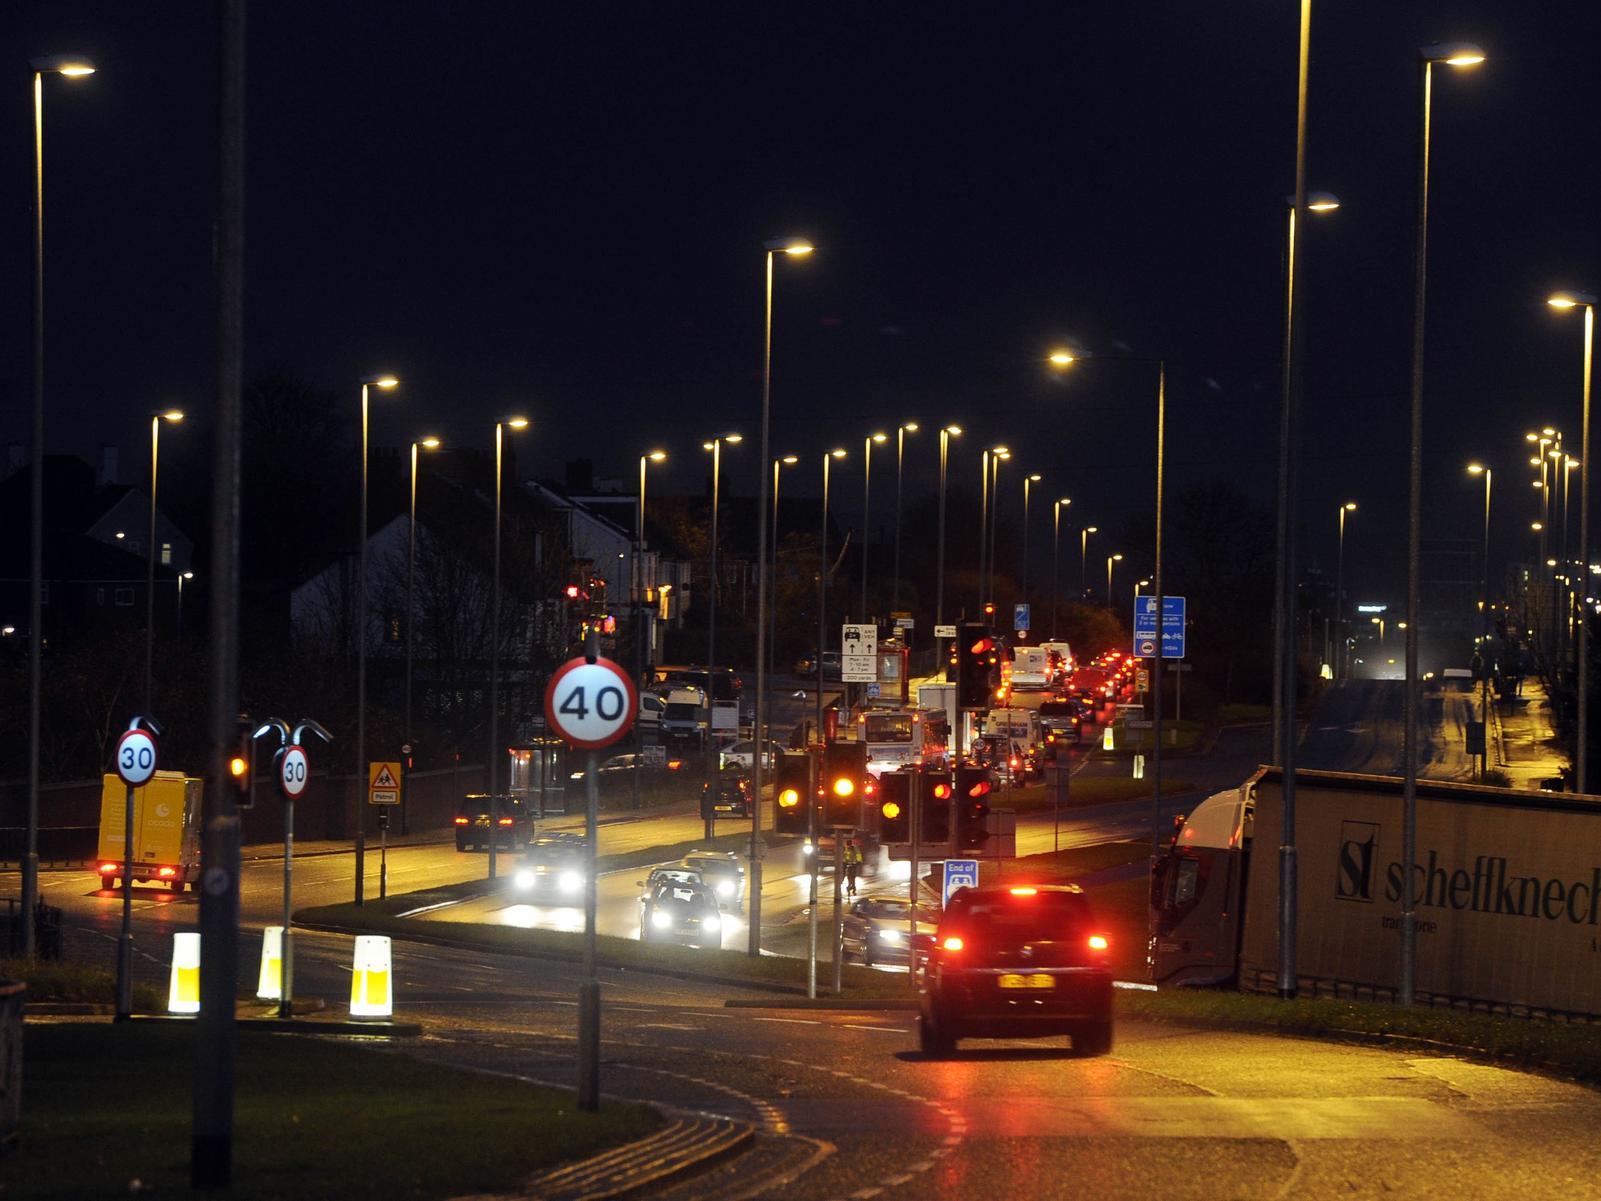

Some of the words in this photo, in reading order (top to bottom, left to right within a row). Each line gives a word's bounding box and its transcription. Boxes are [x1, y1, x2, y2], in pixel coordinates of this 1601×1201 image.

[559, 686, 624, 721] 40
[121, 747, 152, 770] 30
[285, 762, 306, 783] 30
[948, 863, 964, 873] End
[964, 863, 975, 873] of
